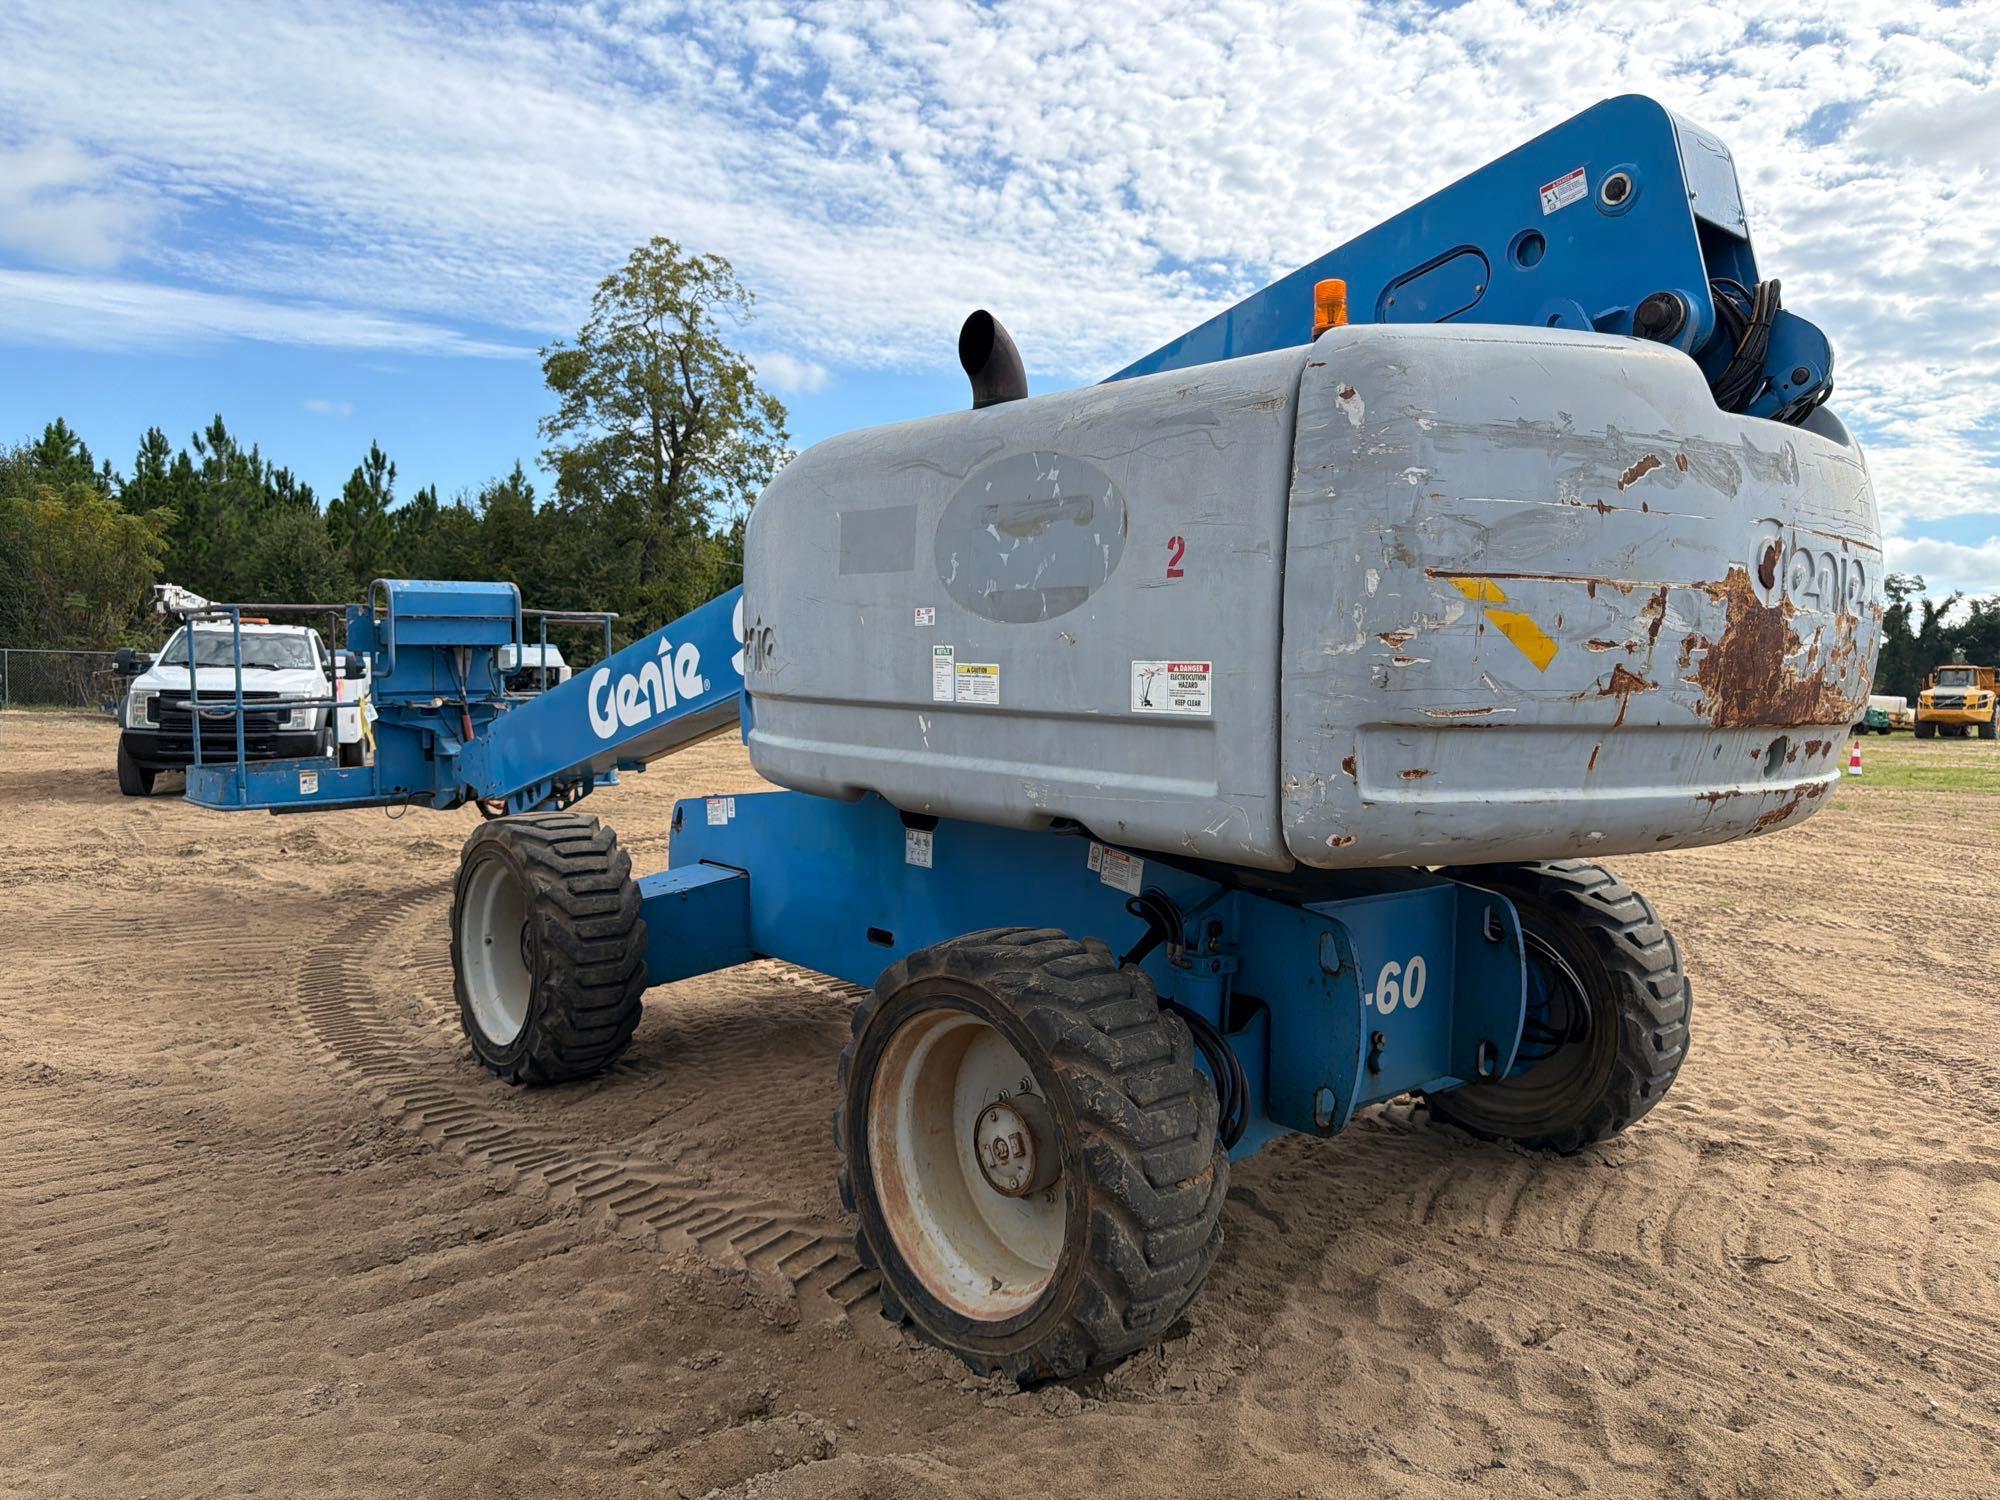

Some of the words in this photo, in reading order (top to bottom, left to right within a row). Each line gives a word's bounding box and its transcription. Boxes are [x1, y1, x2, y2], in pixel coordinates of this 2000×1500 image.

[1167, 536, 1184, 578] 2
[1749, 518, 1865, 617] Genie
[588, 635, 703, 739] Genie
[1170, 673, 1206, 681] ELECTROCUTION
[1180, 664, 1203, 672] DANGER
